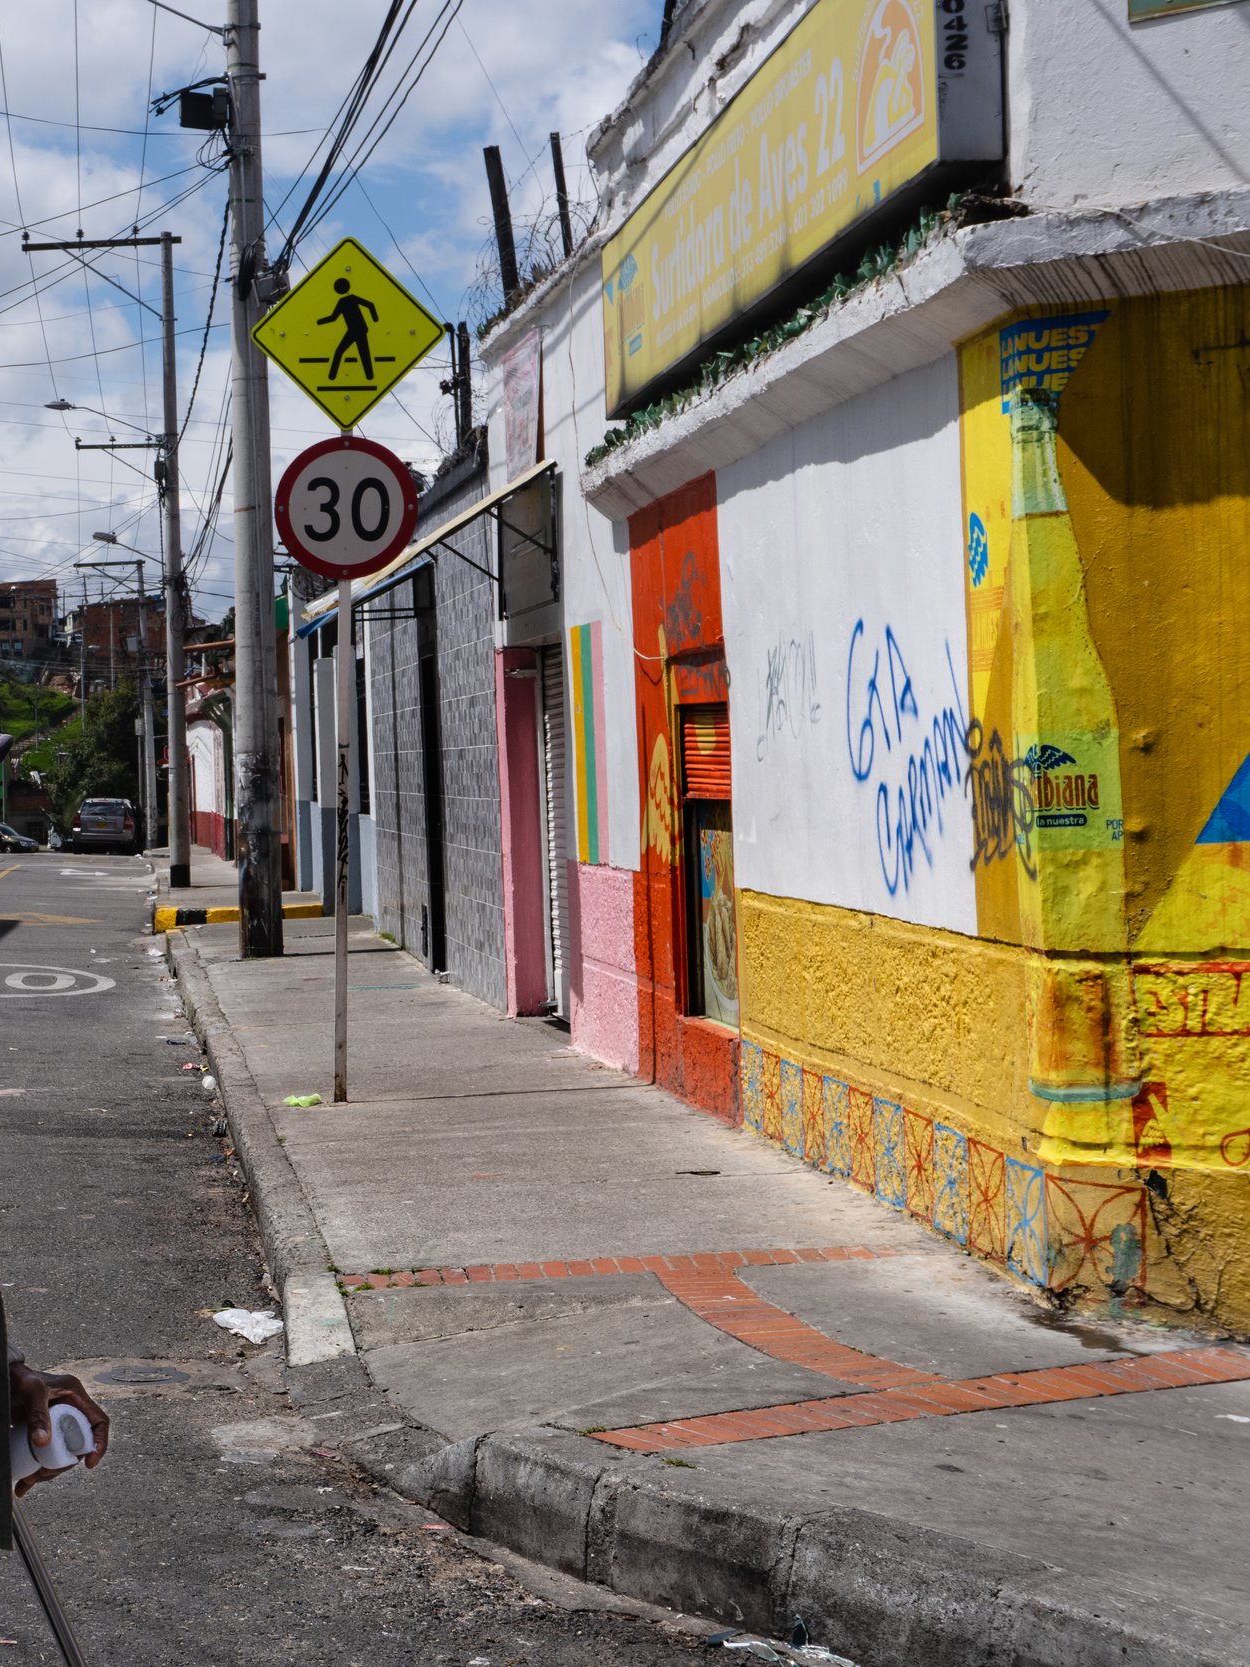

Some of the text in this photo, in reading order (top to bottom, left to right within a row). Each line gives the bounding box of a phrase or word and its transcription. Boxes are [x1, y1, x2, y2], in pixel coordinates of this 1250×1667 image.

[750, 92, 772, 131] POLLO
[651, 204, 724, 321] Surtidora
[729, 156, 753, 257] de
[758, 121, 809, 230] Aves
[814, 55, 846, 177] 22
[303, 476, 391, 543] 30
[1037, 816, 1085, 826] la nuestra
